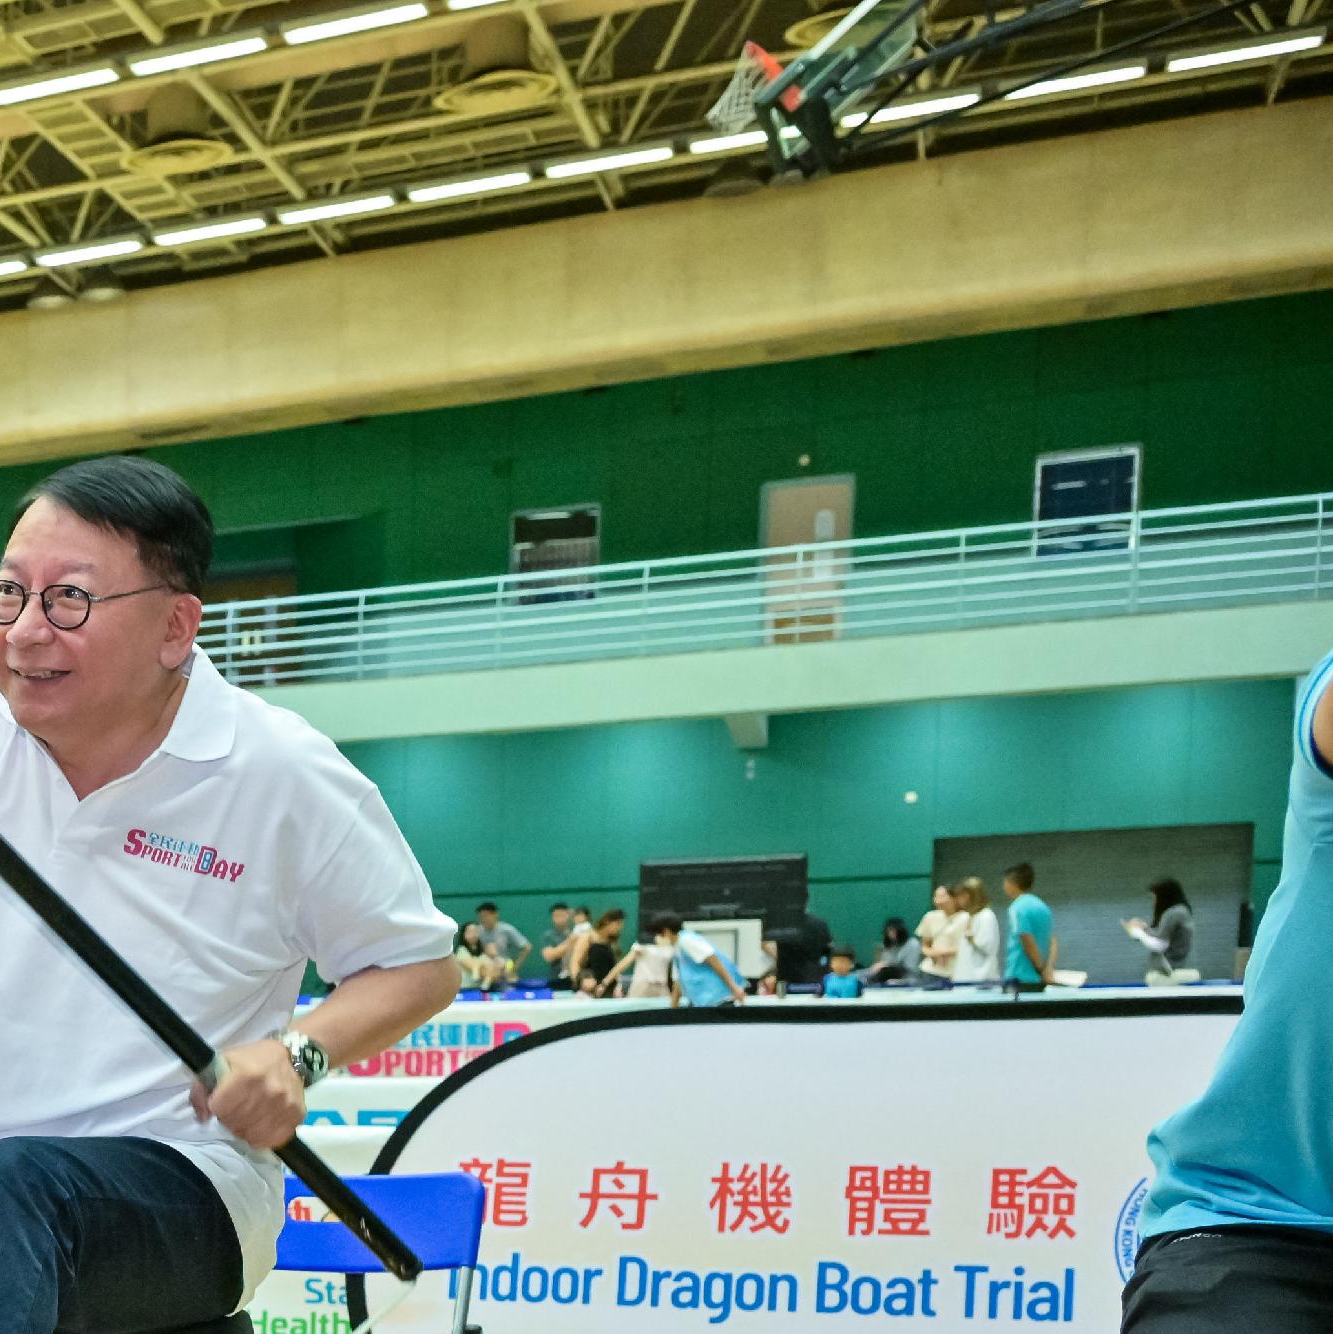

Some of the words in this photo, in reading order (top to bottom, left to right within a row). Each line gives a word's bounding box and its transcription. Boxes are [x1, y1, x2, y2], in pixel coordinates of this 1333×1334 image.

[124, 829, 182, 867] SPORT
[194, 846, 245, 882] DAY
[459, 1158, 1079, 1240] 龍舟機體驗
[617, 1256, 798, 1324] Dragon
[816, 1262, 939, 1318] Boat
[954, 1264, 1075, 1322] Trial
